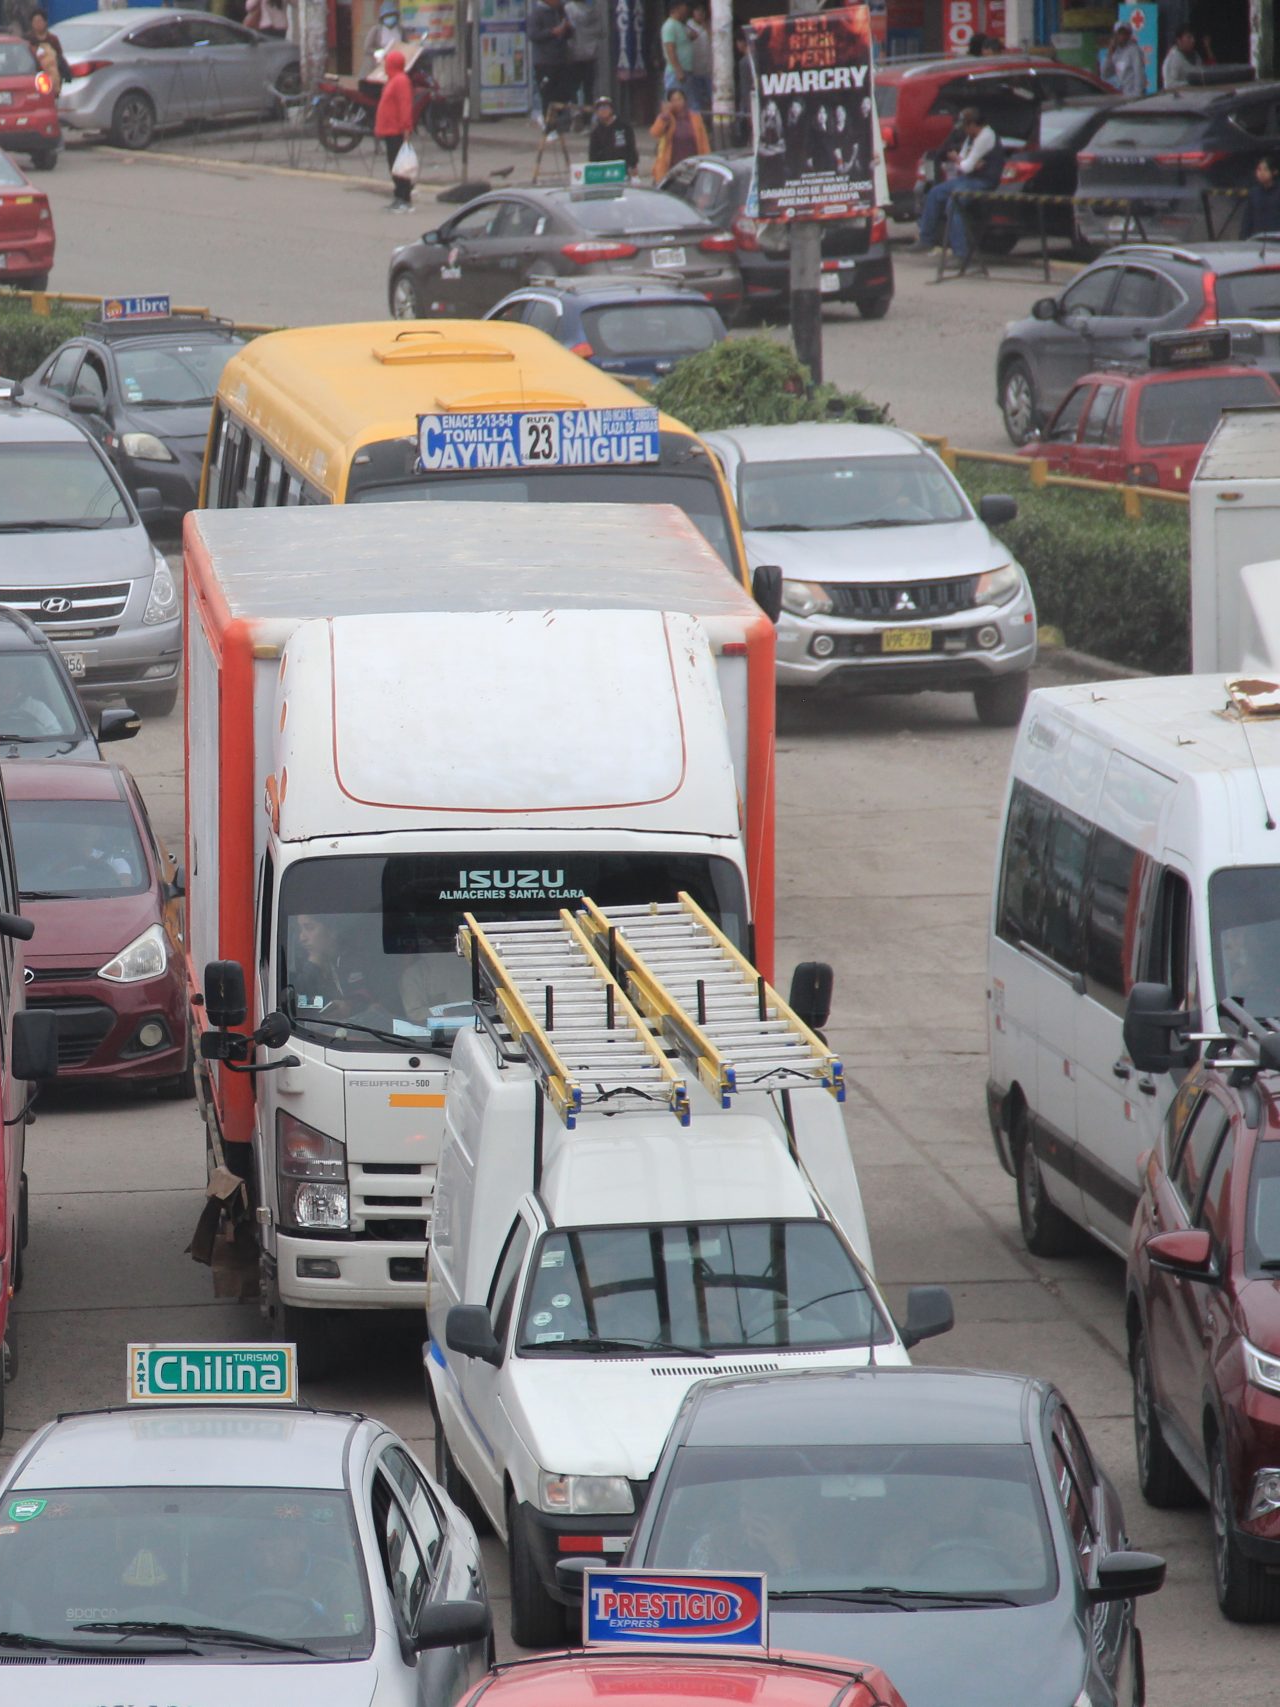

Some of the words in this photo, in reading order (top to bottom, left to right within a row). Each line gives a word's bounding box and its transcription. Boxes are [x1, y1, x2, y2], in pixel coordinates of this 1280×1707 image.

[761, 65, 868, 95] WARCRY
[126, 298, 168, 314] Libre
[442, 415, 475, 428] ENACE
[562, 411, 602, 439] SAN
[443, 428, 514, 443] TOMILLA
[528, 424, 553, 461] 23
[563, 435, 659, 464] MIGUEL
[460, 870, 564, 888] ISUZU
[439, 890, 506, 899] ALMACENES
[509, 890, 545, 898] SANTA
[548, 889, 585, 898] CLARA
[233, 1353, 279, 1362] TURISMO
[137, 1352, 146, 1394] TAXI
[154, 1356, 282, 1391] Chilina
[66, 1607, 118, 1619] sparco
[609, 1619, 660, 1629] EXPRESS
